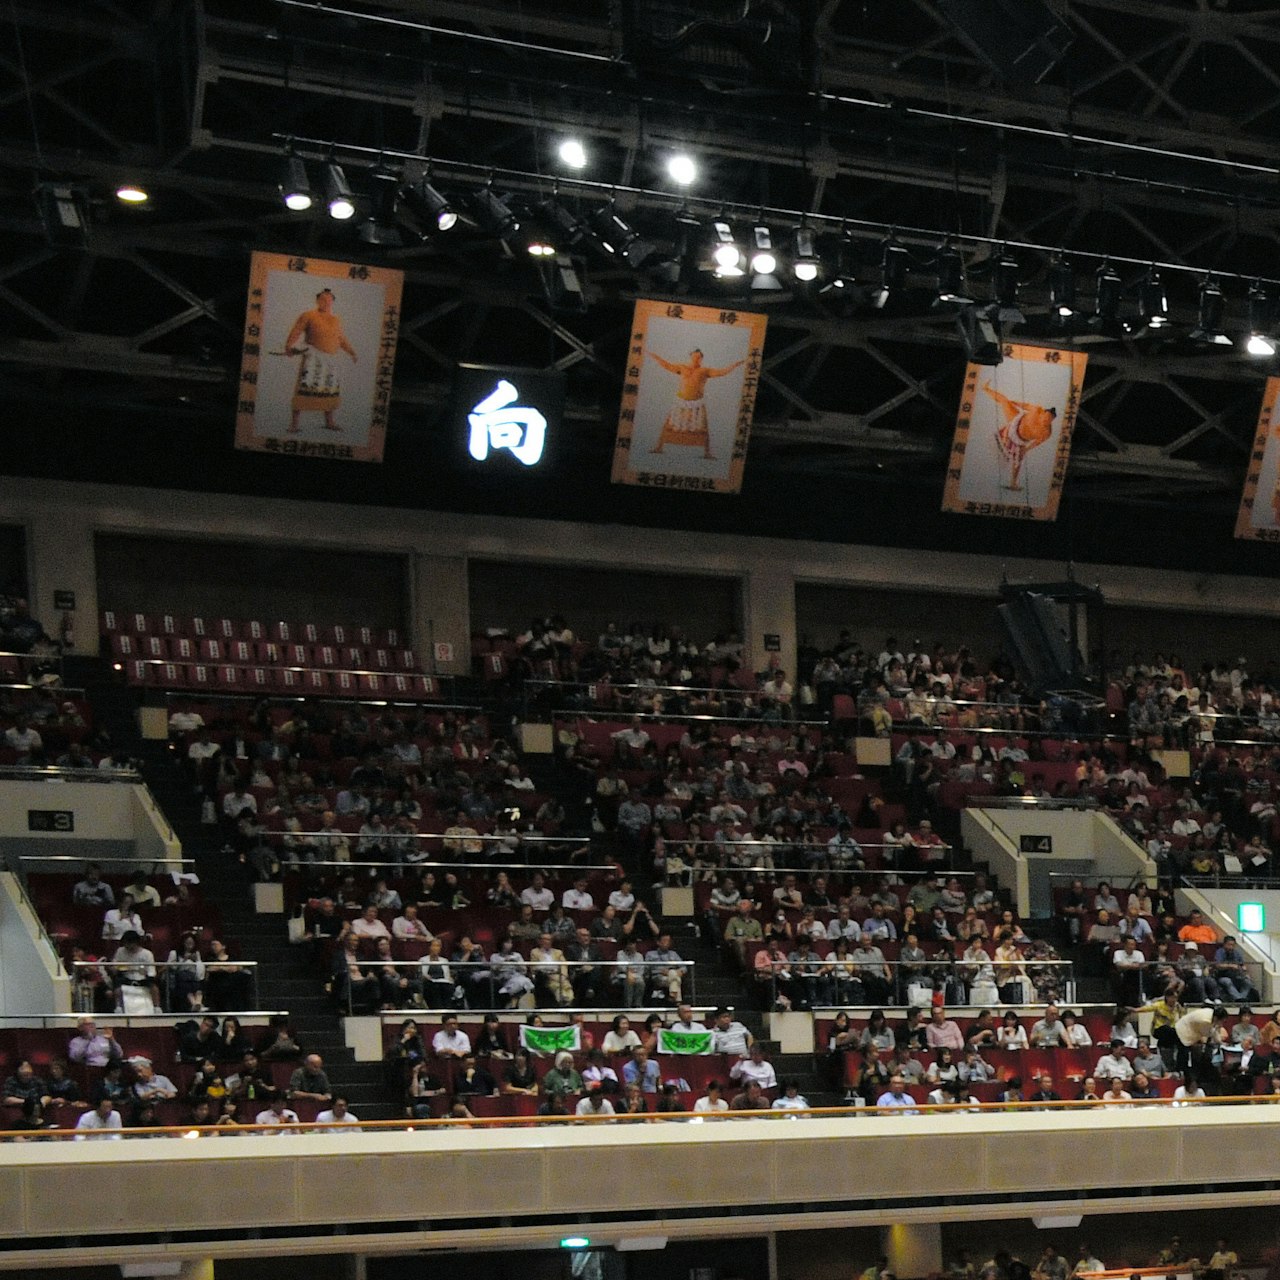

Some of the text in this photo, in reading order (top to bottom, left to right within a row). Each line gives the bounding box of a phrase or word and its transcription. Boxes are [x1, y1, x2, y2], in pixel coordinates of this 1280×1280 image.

[666, 305, 739, 325] 優勝
[467, 379, 548, 467] 向
[266, 438, 354, 458] 毎日新聞社
[638, 472, 715, 490] 毎日新聞社
[1038, 838, 1049, 850] 4
